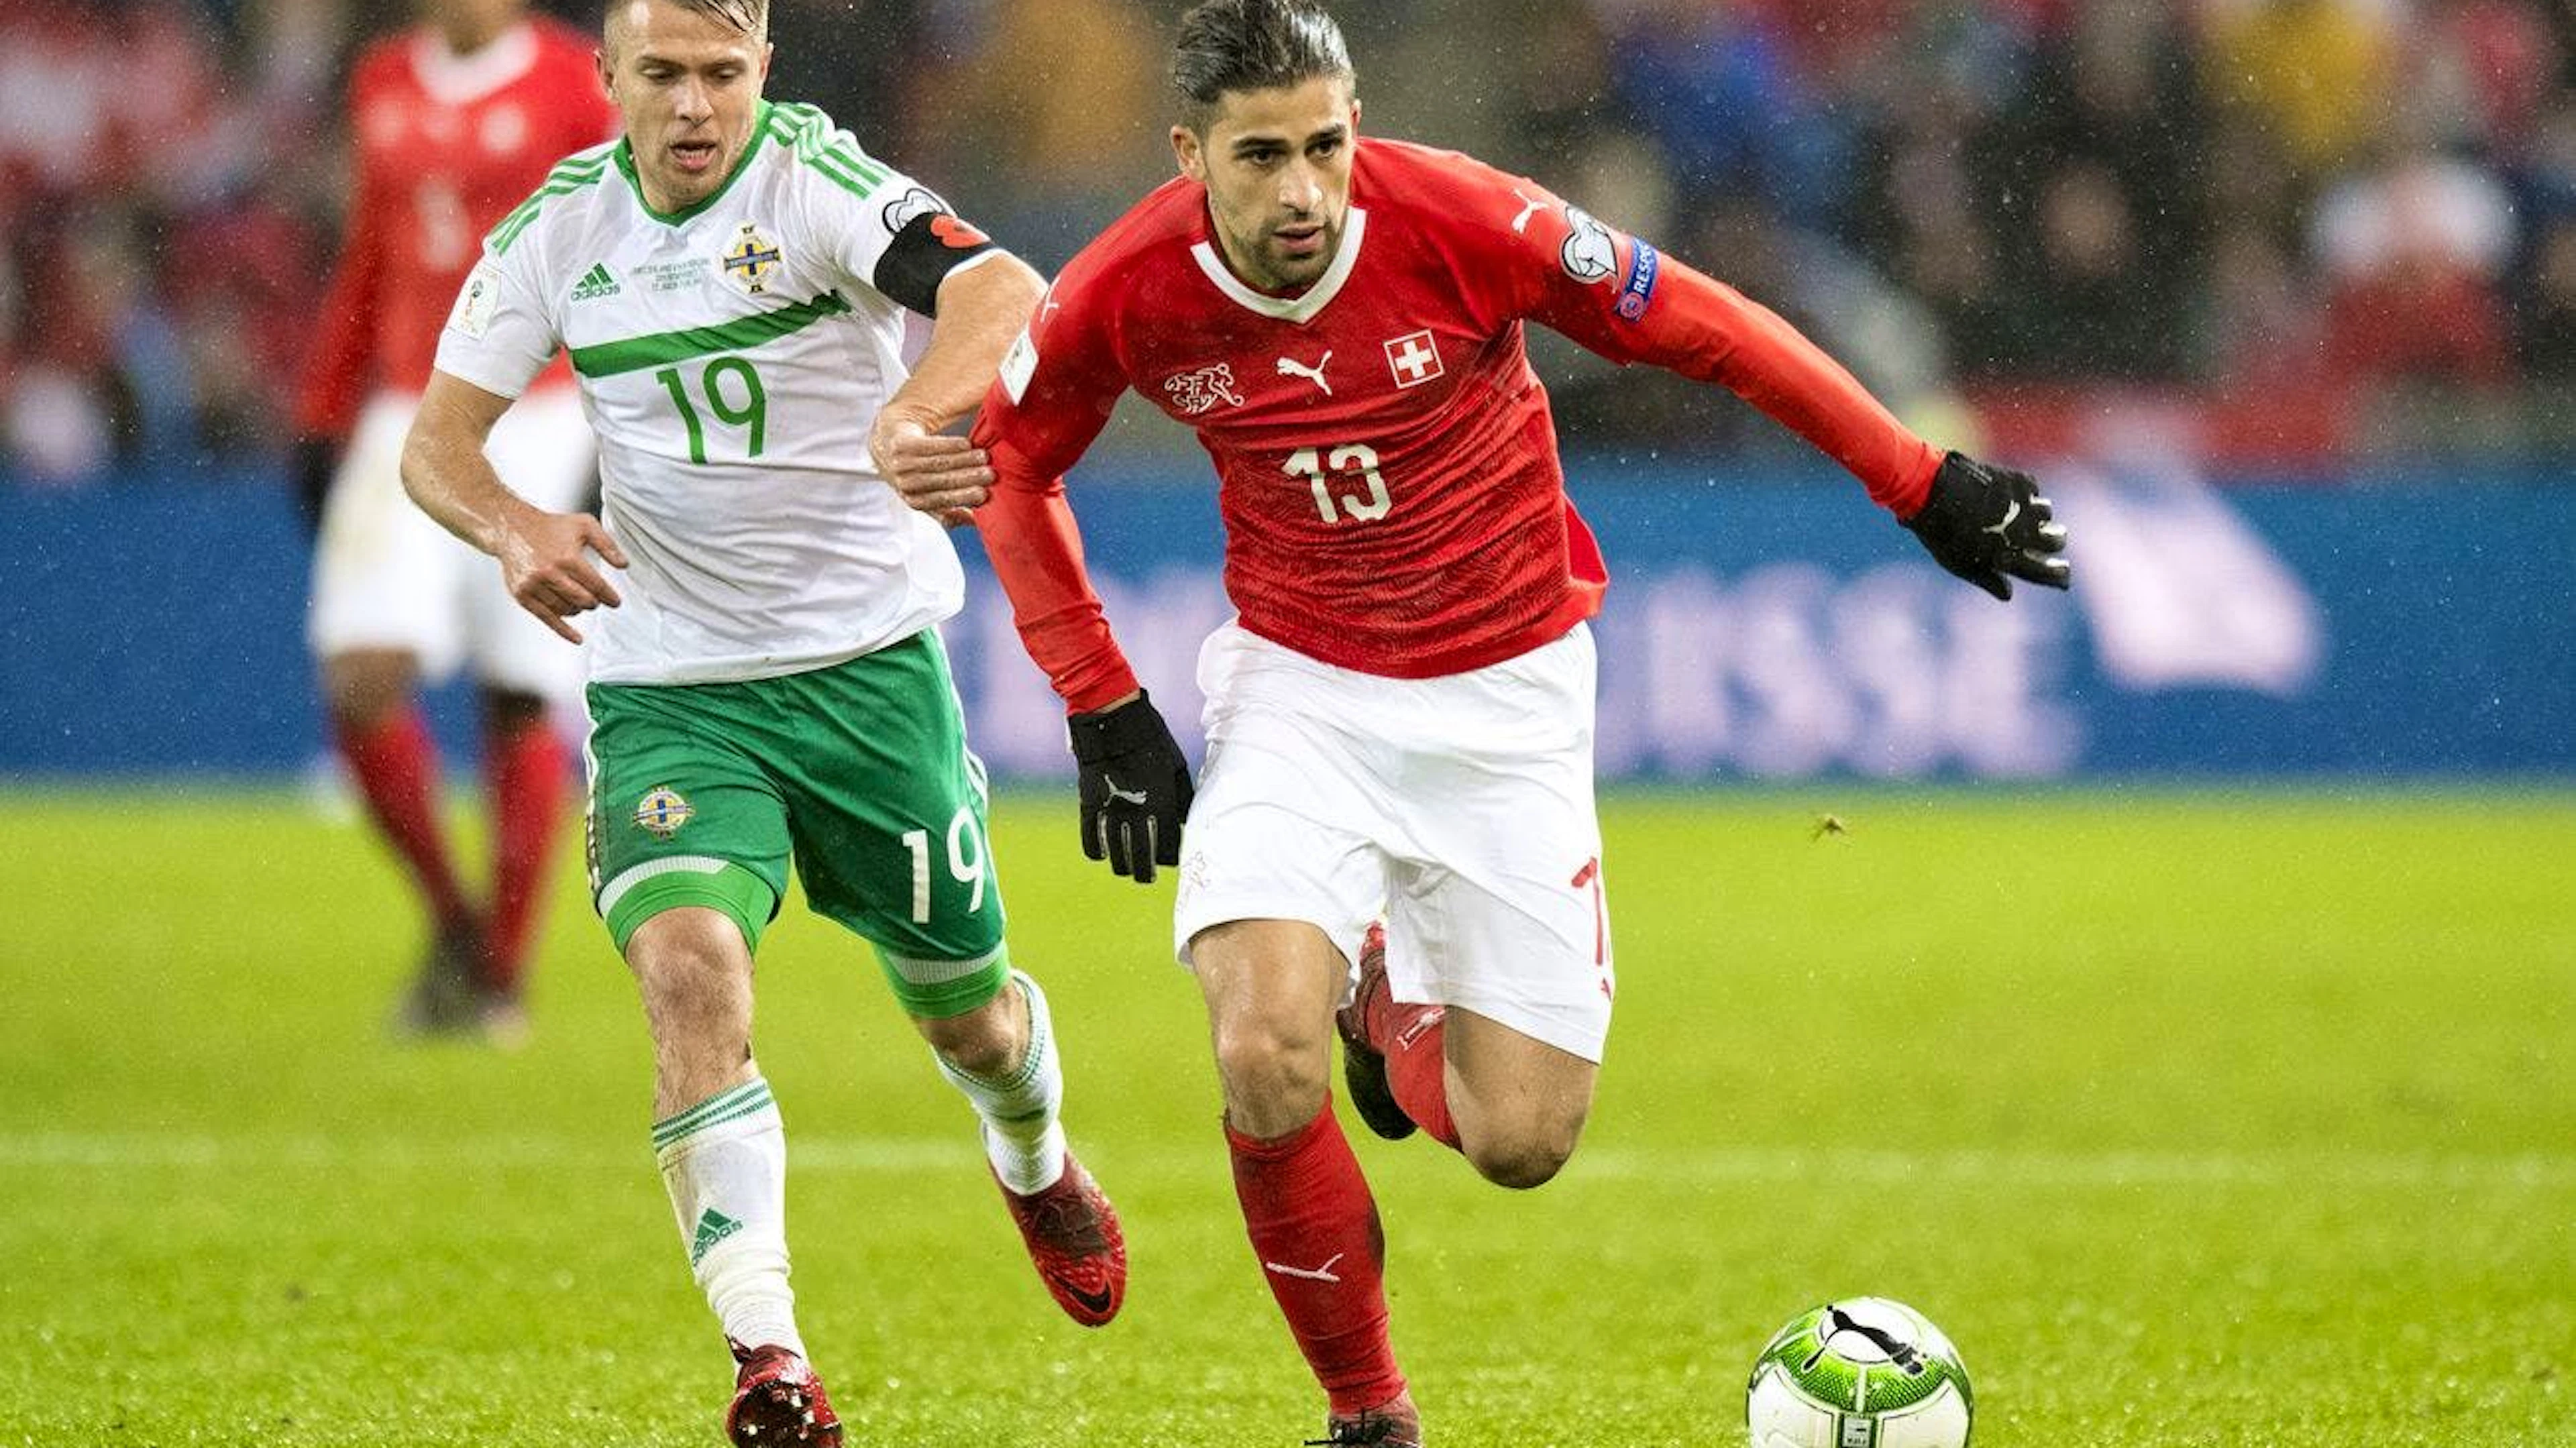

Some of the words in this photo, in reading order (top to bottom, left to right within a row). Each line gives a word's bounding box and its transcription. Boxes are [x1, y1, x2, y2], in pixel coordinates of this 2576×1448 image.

[570, 283, 621, 301] adidas
[1633, 238, 1653, 294] RESPE
[656, 356, 765, 464] 19
[1281, 443, 1393, 524] 13
[902, 807, 983, 924] 19
[692, 1219, 743, 1267] adidas
